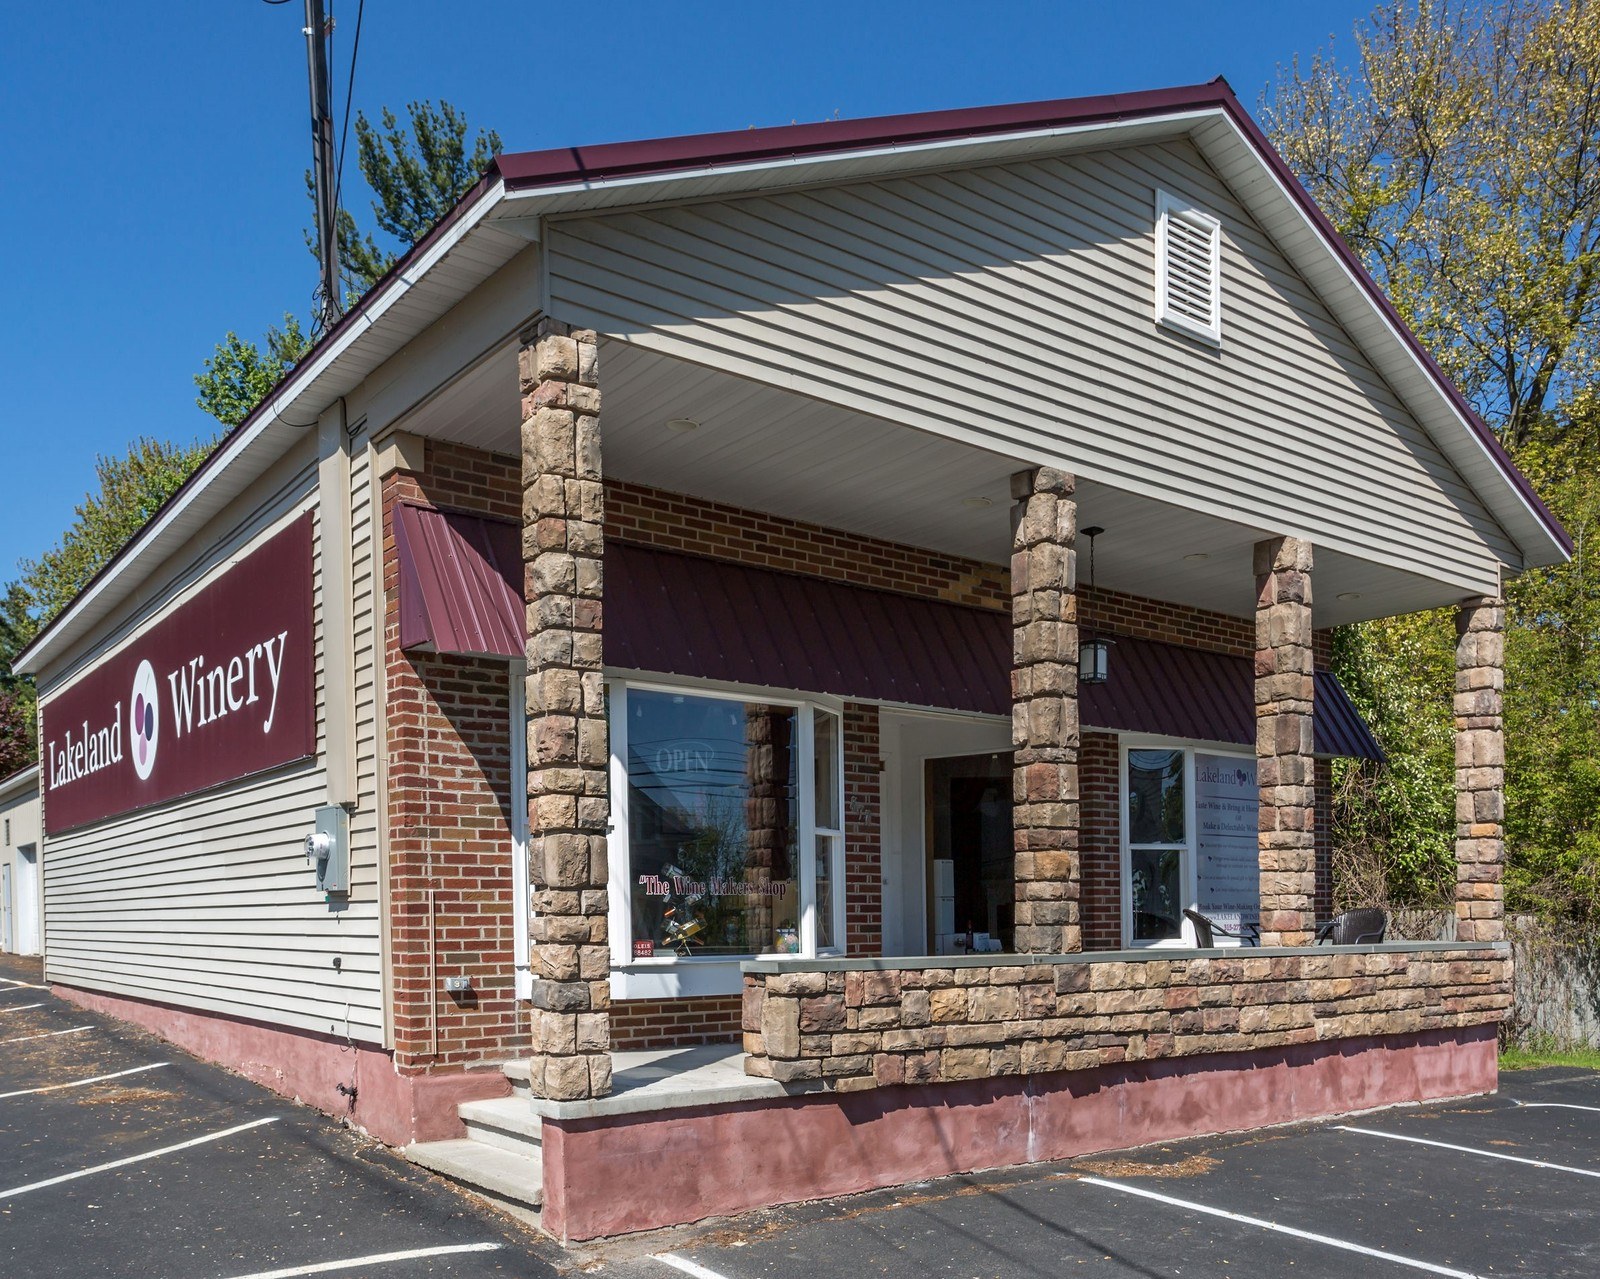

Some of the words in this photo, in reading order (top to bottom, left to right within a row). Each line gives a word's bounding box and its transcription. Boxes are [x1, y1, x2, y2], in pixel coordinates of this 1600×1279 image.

[49, 701, 123, 790] Lakeland
[168, 630, 287, 738] Winery
[656, 748, 709, 773] OPEN
[1196, 766, 1236, 785] Lakeland
[1203, 821, 1216, 830] Make
[673, 875, 706, 896] Wine
[710, 876, 754, 896] Makers
